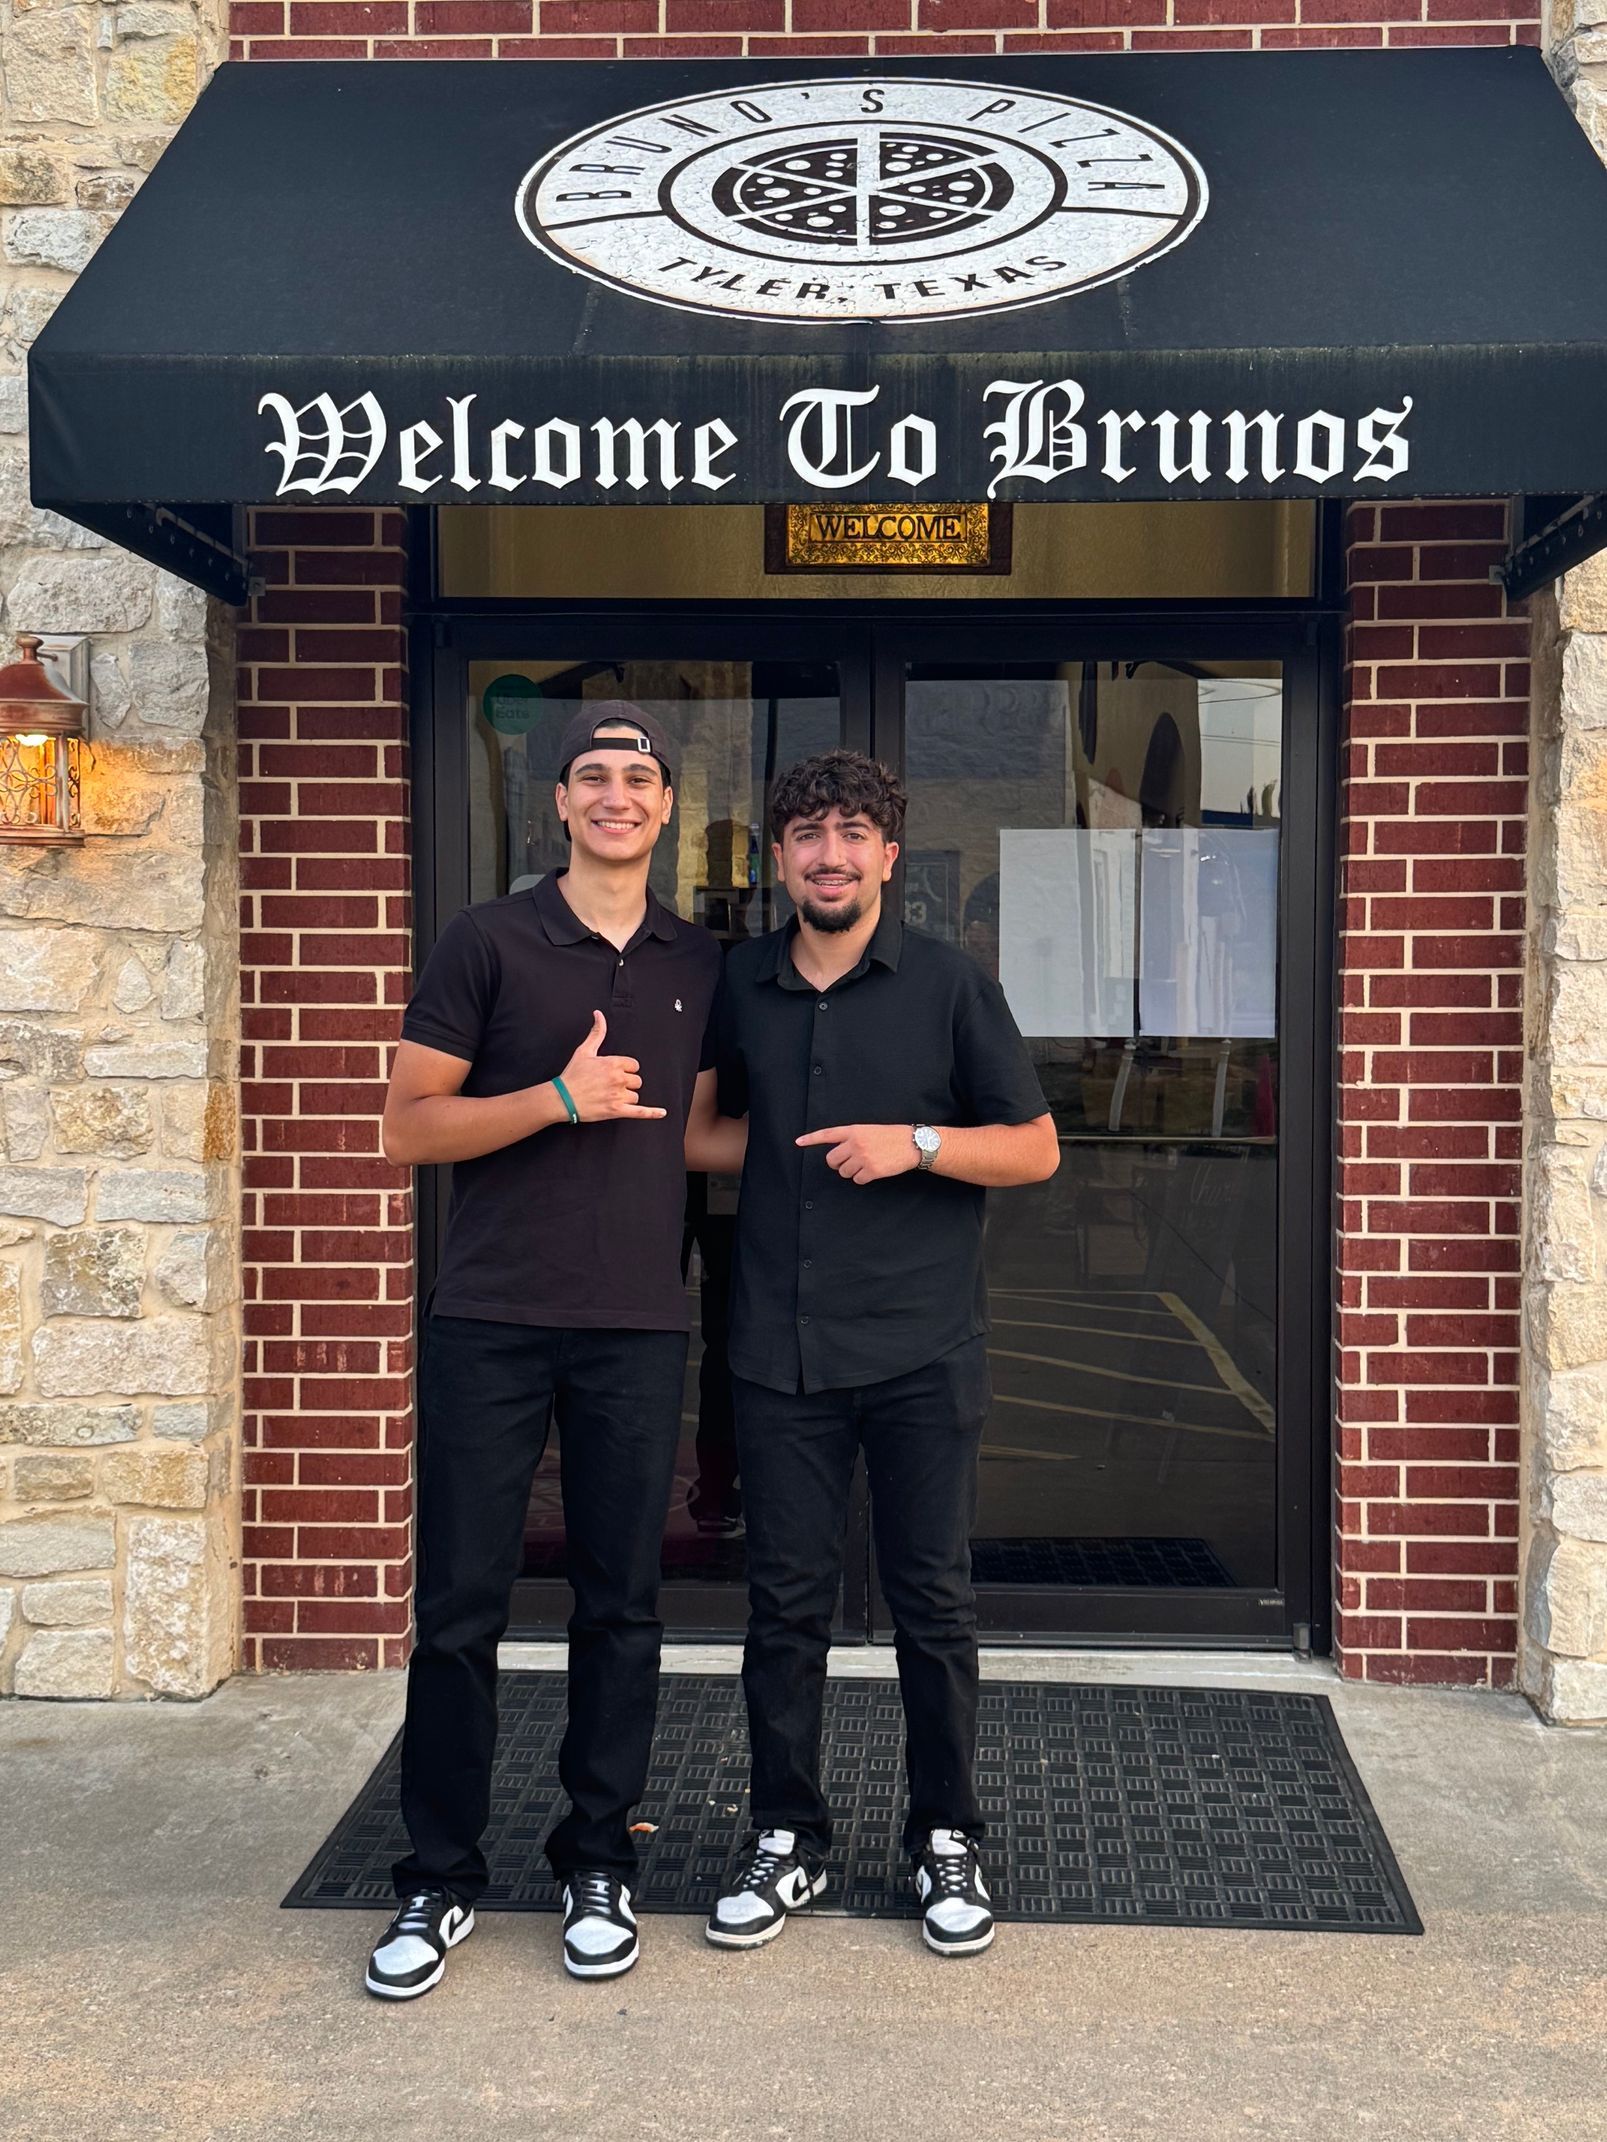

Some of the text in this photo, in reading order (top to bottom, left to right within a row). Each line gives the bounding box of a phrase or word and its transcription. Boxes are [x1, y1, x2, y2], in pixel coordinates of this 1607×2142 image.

[555, 87, 1166, 203] BRUNO'S PIZZA
[656, 254, 1068, 303] TYLER, TEXAS
[256, 379, 1414, 501] Welcome To Brunos
[815, 514, 962, 541] WELCOME
[495, 706, 530, 719] Eats
